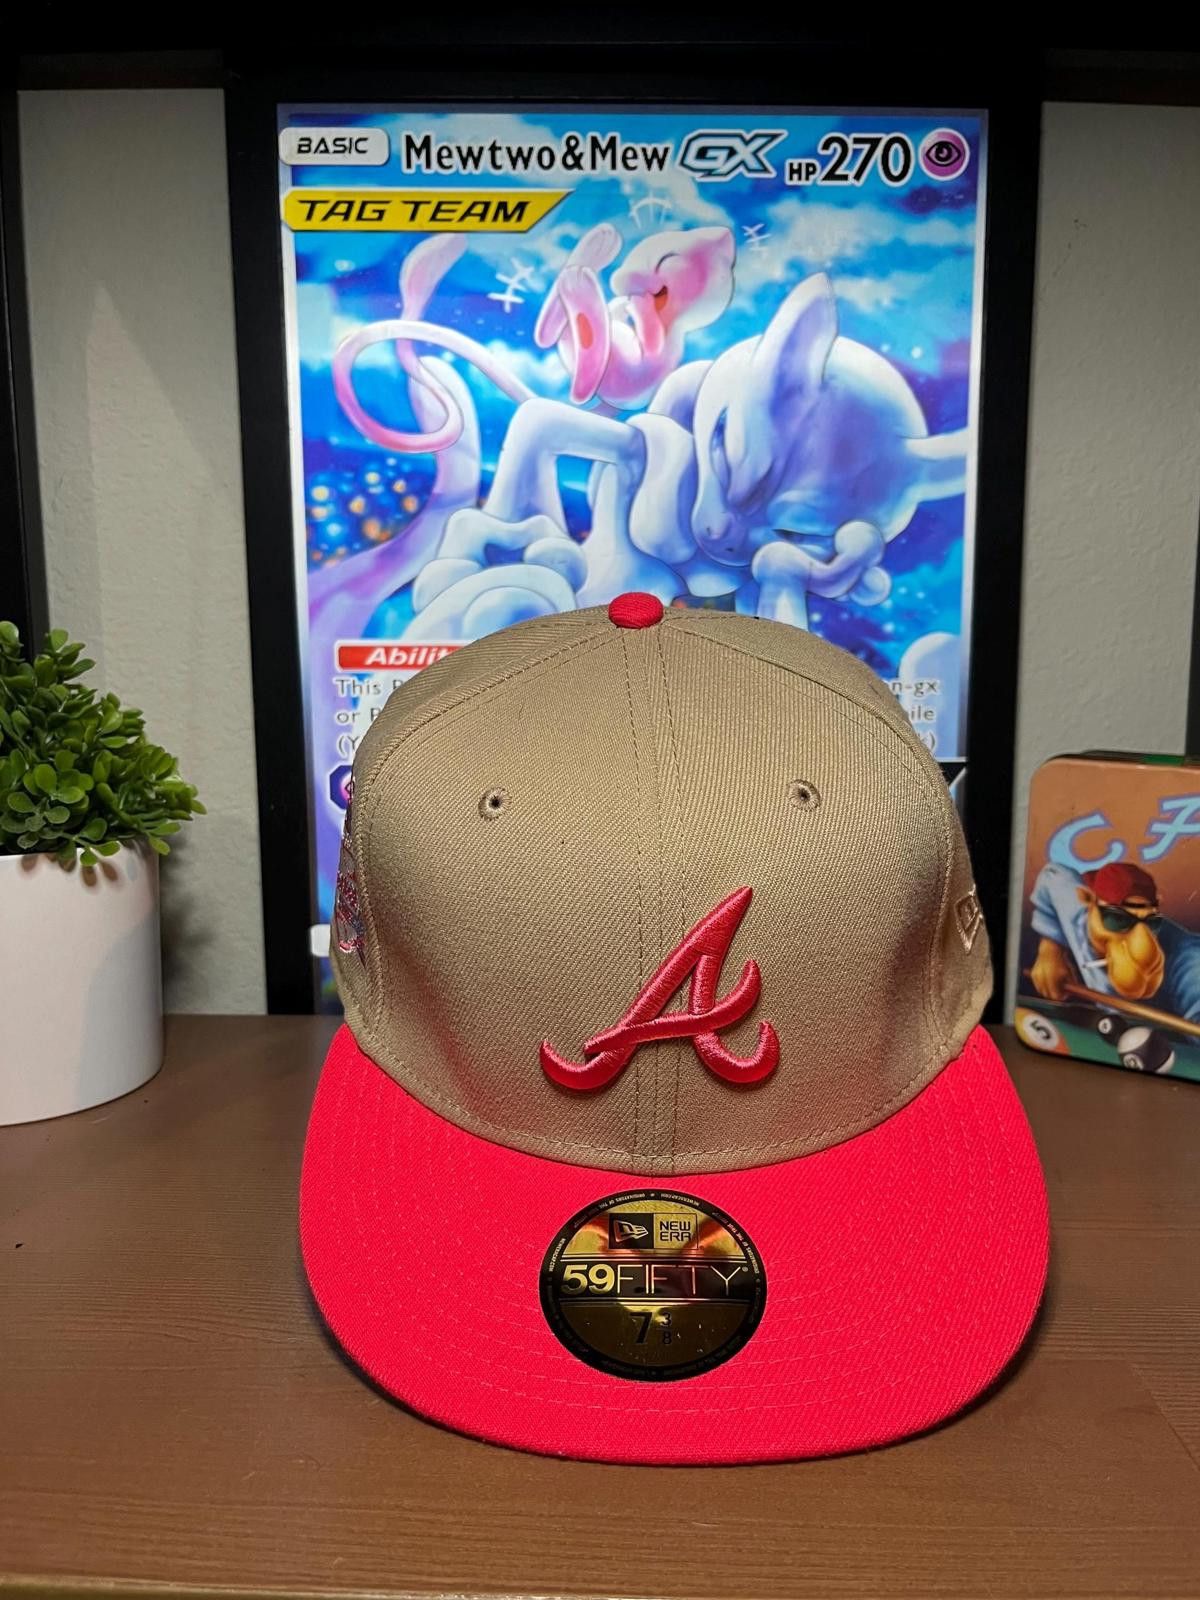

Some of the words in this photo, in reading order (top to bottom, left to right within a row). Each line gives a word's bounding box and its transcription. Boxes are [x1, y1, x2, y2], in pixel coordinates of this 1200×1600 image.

[297, 137, 369, 154] BASIC
[404, 134, 669, 171] Mewtwo&Mew
[678, 132, 787, 177] GX
[789, 162, 816, 181] HP
[820, 136, 912, 181] 270
[297, 200, 391, 221] TAG
[402, 200, 531, 222] TEAM
[364, 647, 455, 666] Abilit
[335, 678, 382, 695] This
[336, 711, 360, 724] or
[909, 705, 935, 721] ile
[540, 885, 780, 1090] A
[659, 1220, 691, 1231] NEW
[659, 1231, 692, 1242] ERA
[629, 1311, 653, 1345] 7
